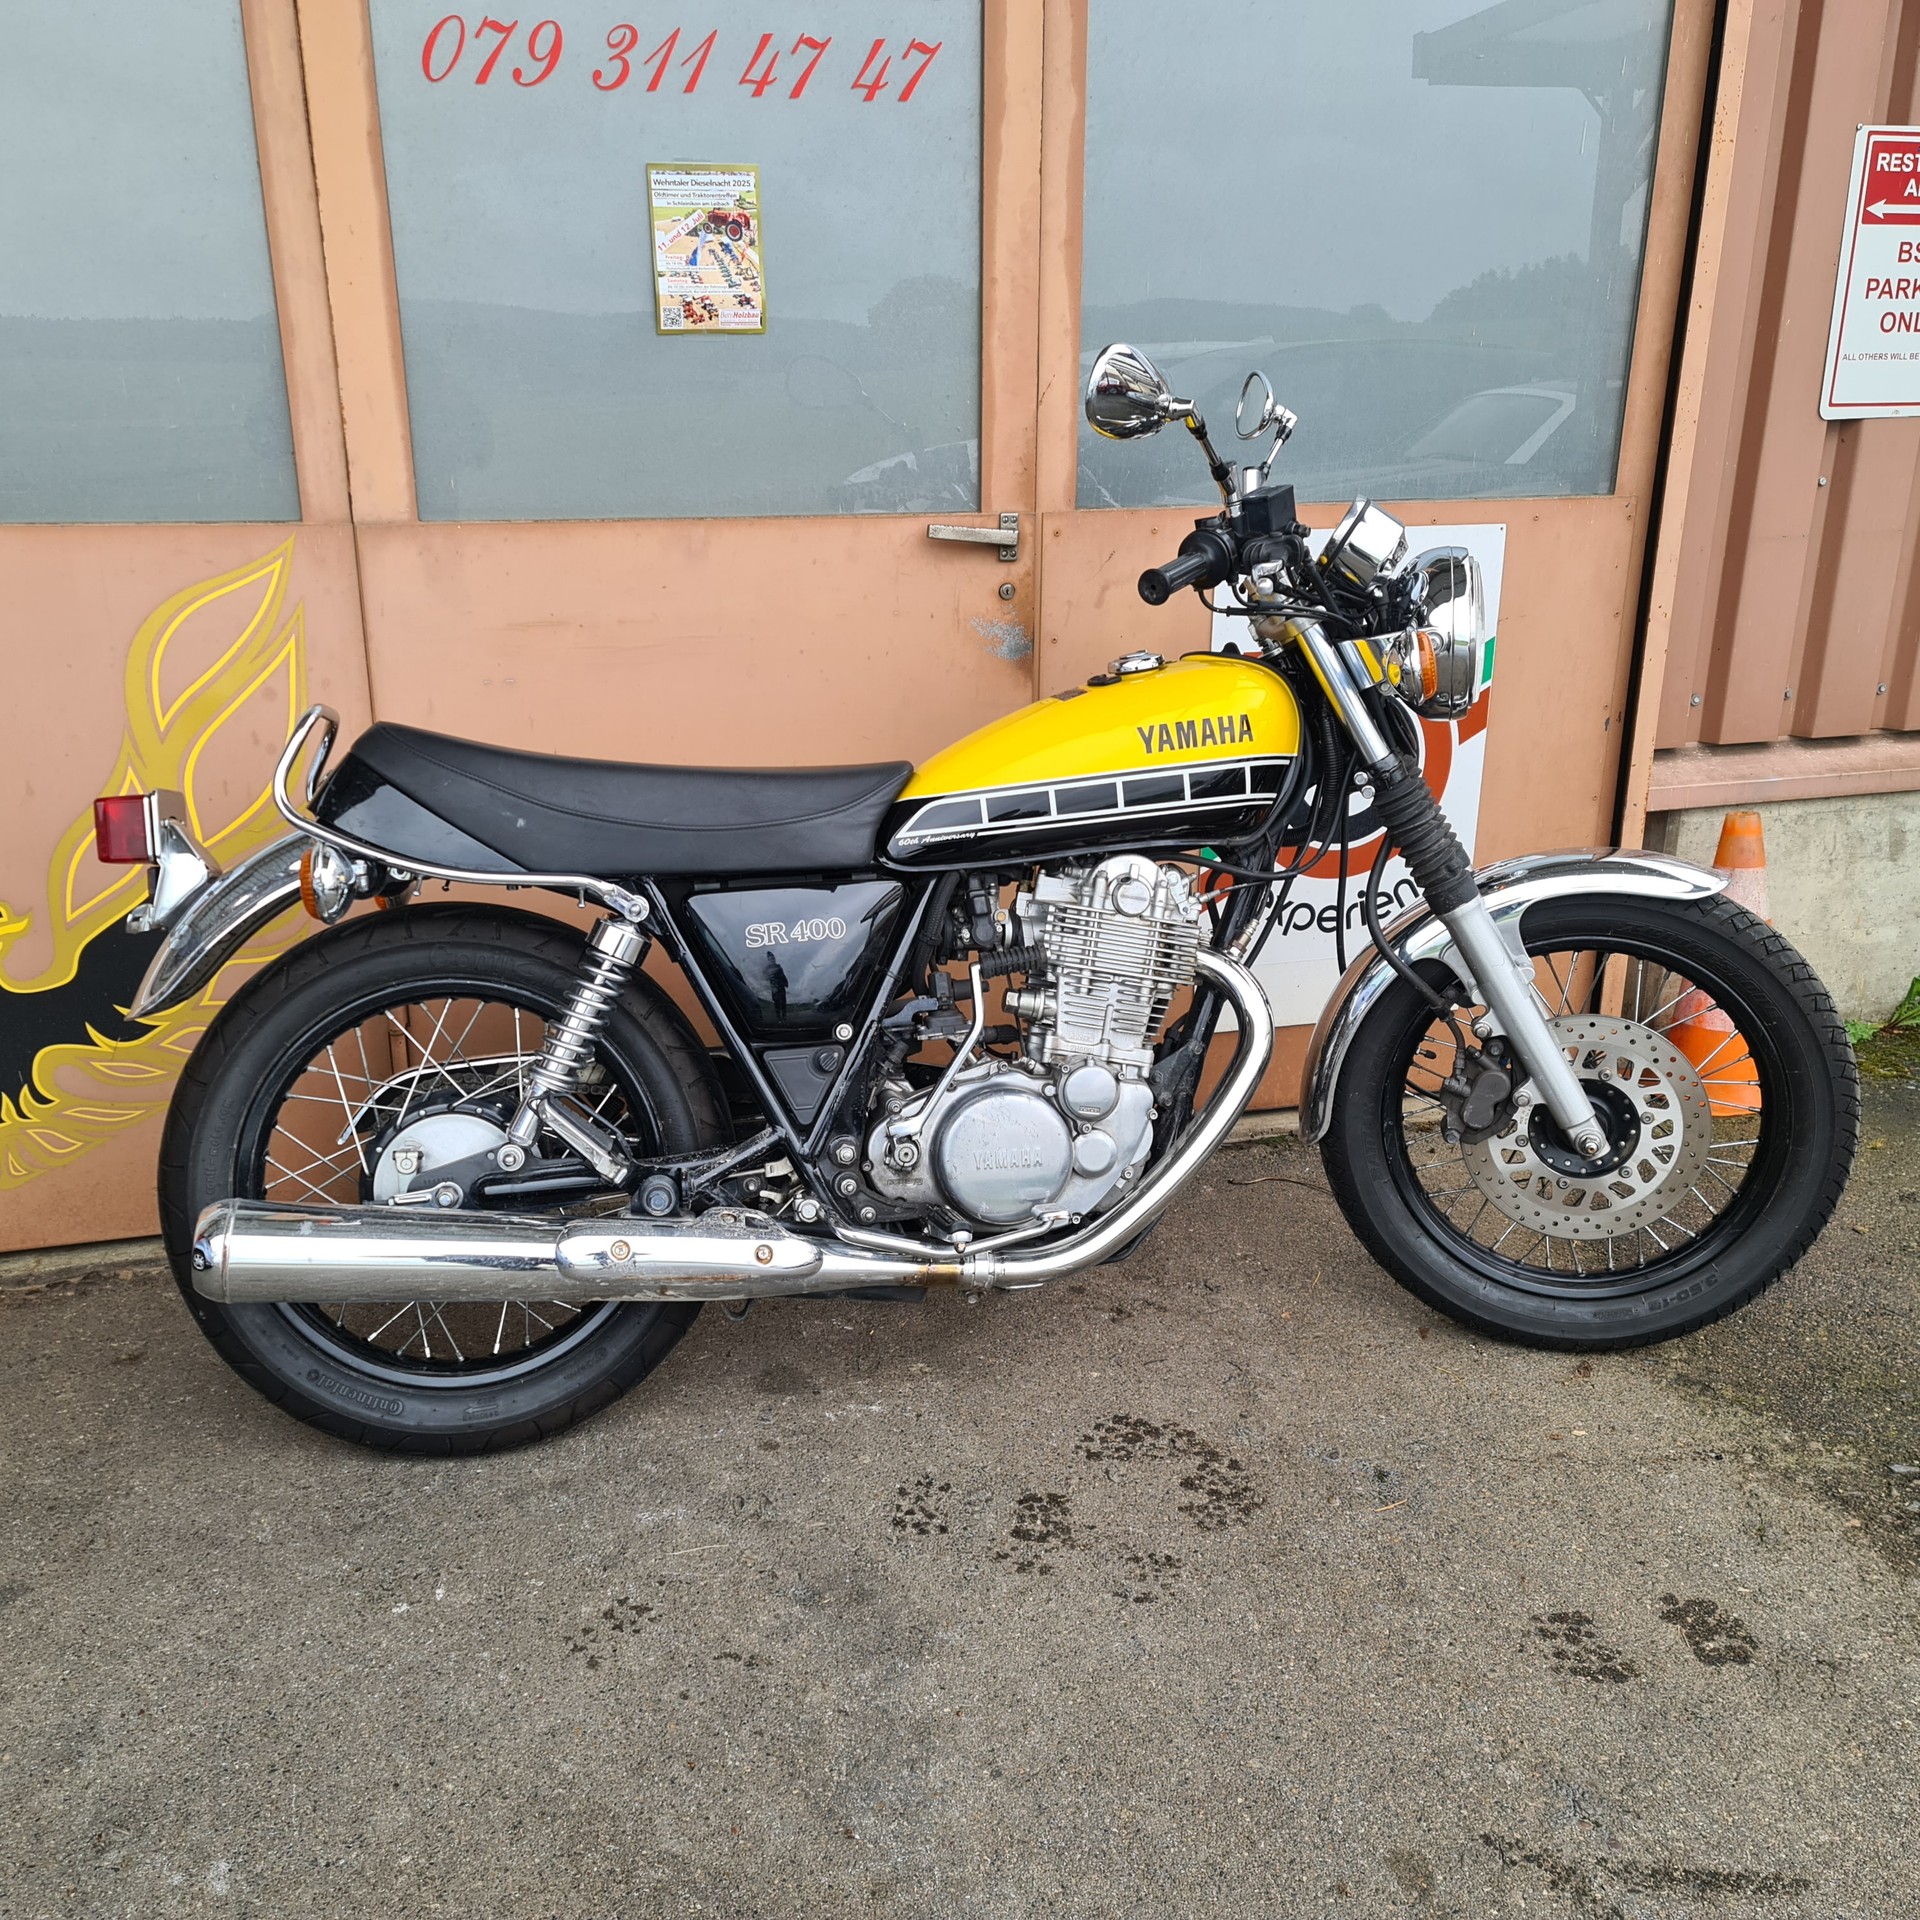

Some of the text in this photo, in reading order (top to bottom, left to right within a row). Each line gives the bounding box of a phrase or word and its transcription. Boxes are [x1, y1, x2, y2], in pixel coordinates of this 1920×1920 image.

[422, 16, 943, 103] 079 311 47 47
[653, 178, 751, 188] Wehntaler Dieselnacht 2025
[1904, 178, 1920, 197] A
[668, 231, 681, 245] und
[692, 212, 704, 225] Juli
[1842, 353, 1857, 361] ALL
[1858, 352, 1888, 361] OTHERS
[1890, 352, 1908, 361] WILL
[1137, 714, 1254, 754] YAMAHA
[898, 832, 976, 847] 60th Anniversary
[745, 917, 847, 948] SR 400
[973, 1146, 1043, 1170] YAMAHA
